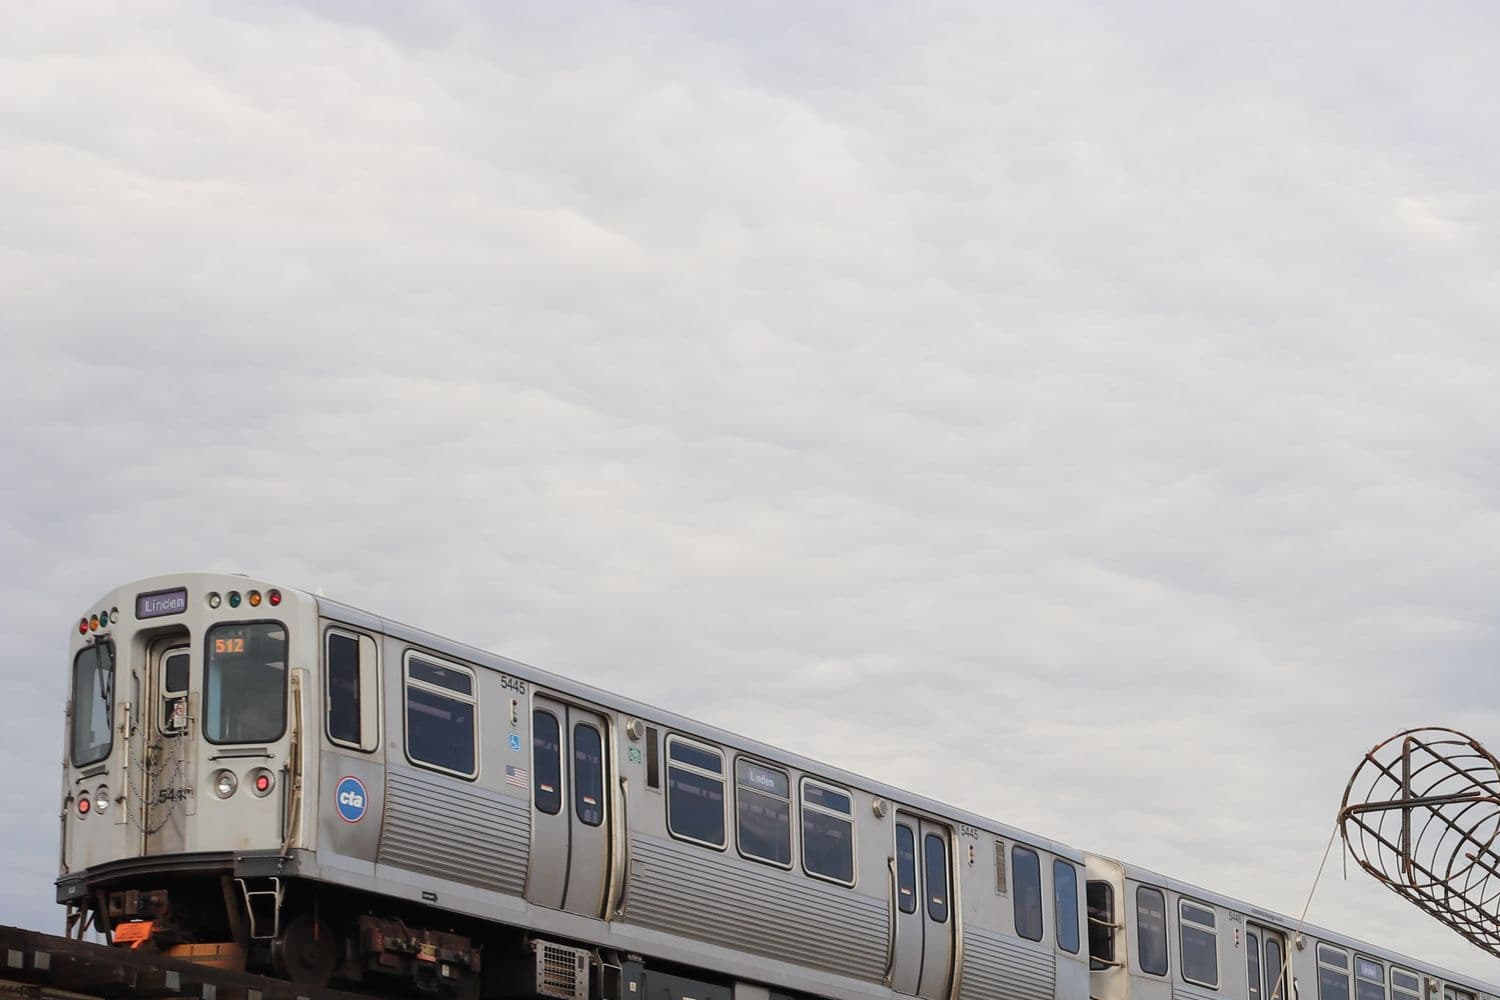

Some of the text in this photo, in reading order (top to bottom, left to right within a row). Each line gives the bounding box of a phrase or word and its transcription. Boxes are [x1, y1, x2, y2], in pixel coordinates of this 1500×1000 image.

[145, 597, 185, 612] Linden
[215, 639, 244, 653] 512
[501, 675, 525, 695] 5445
[340, 791, 364, 808] cta
